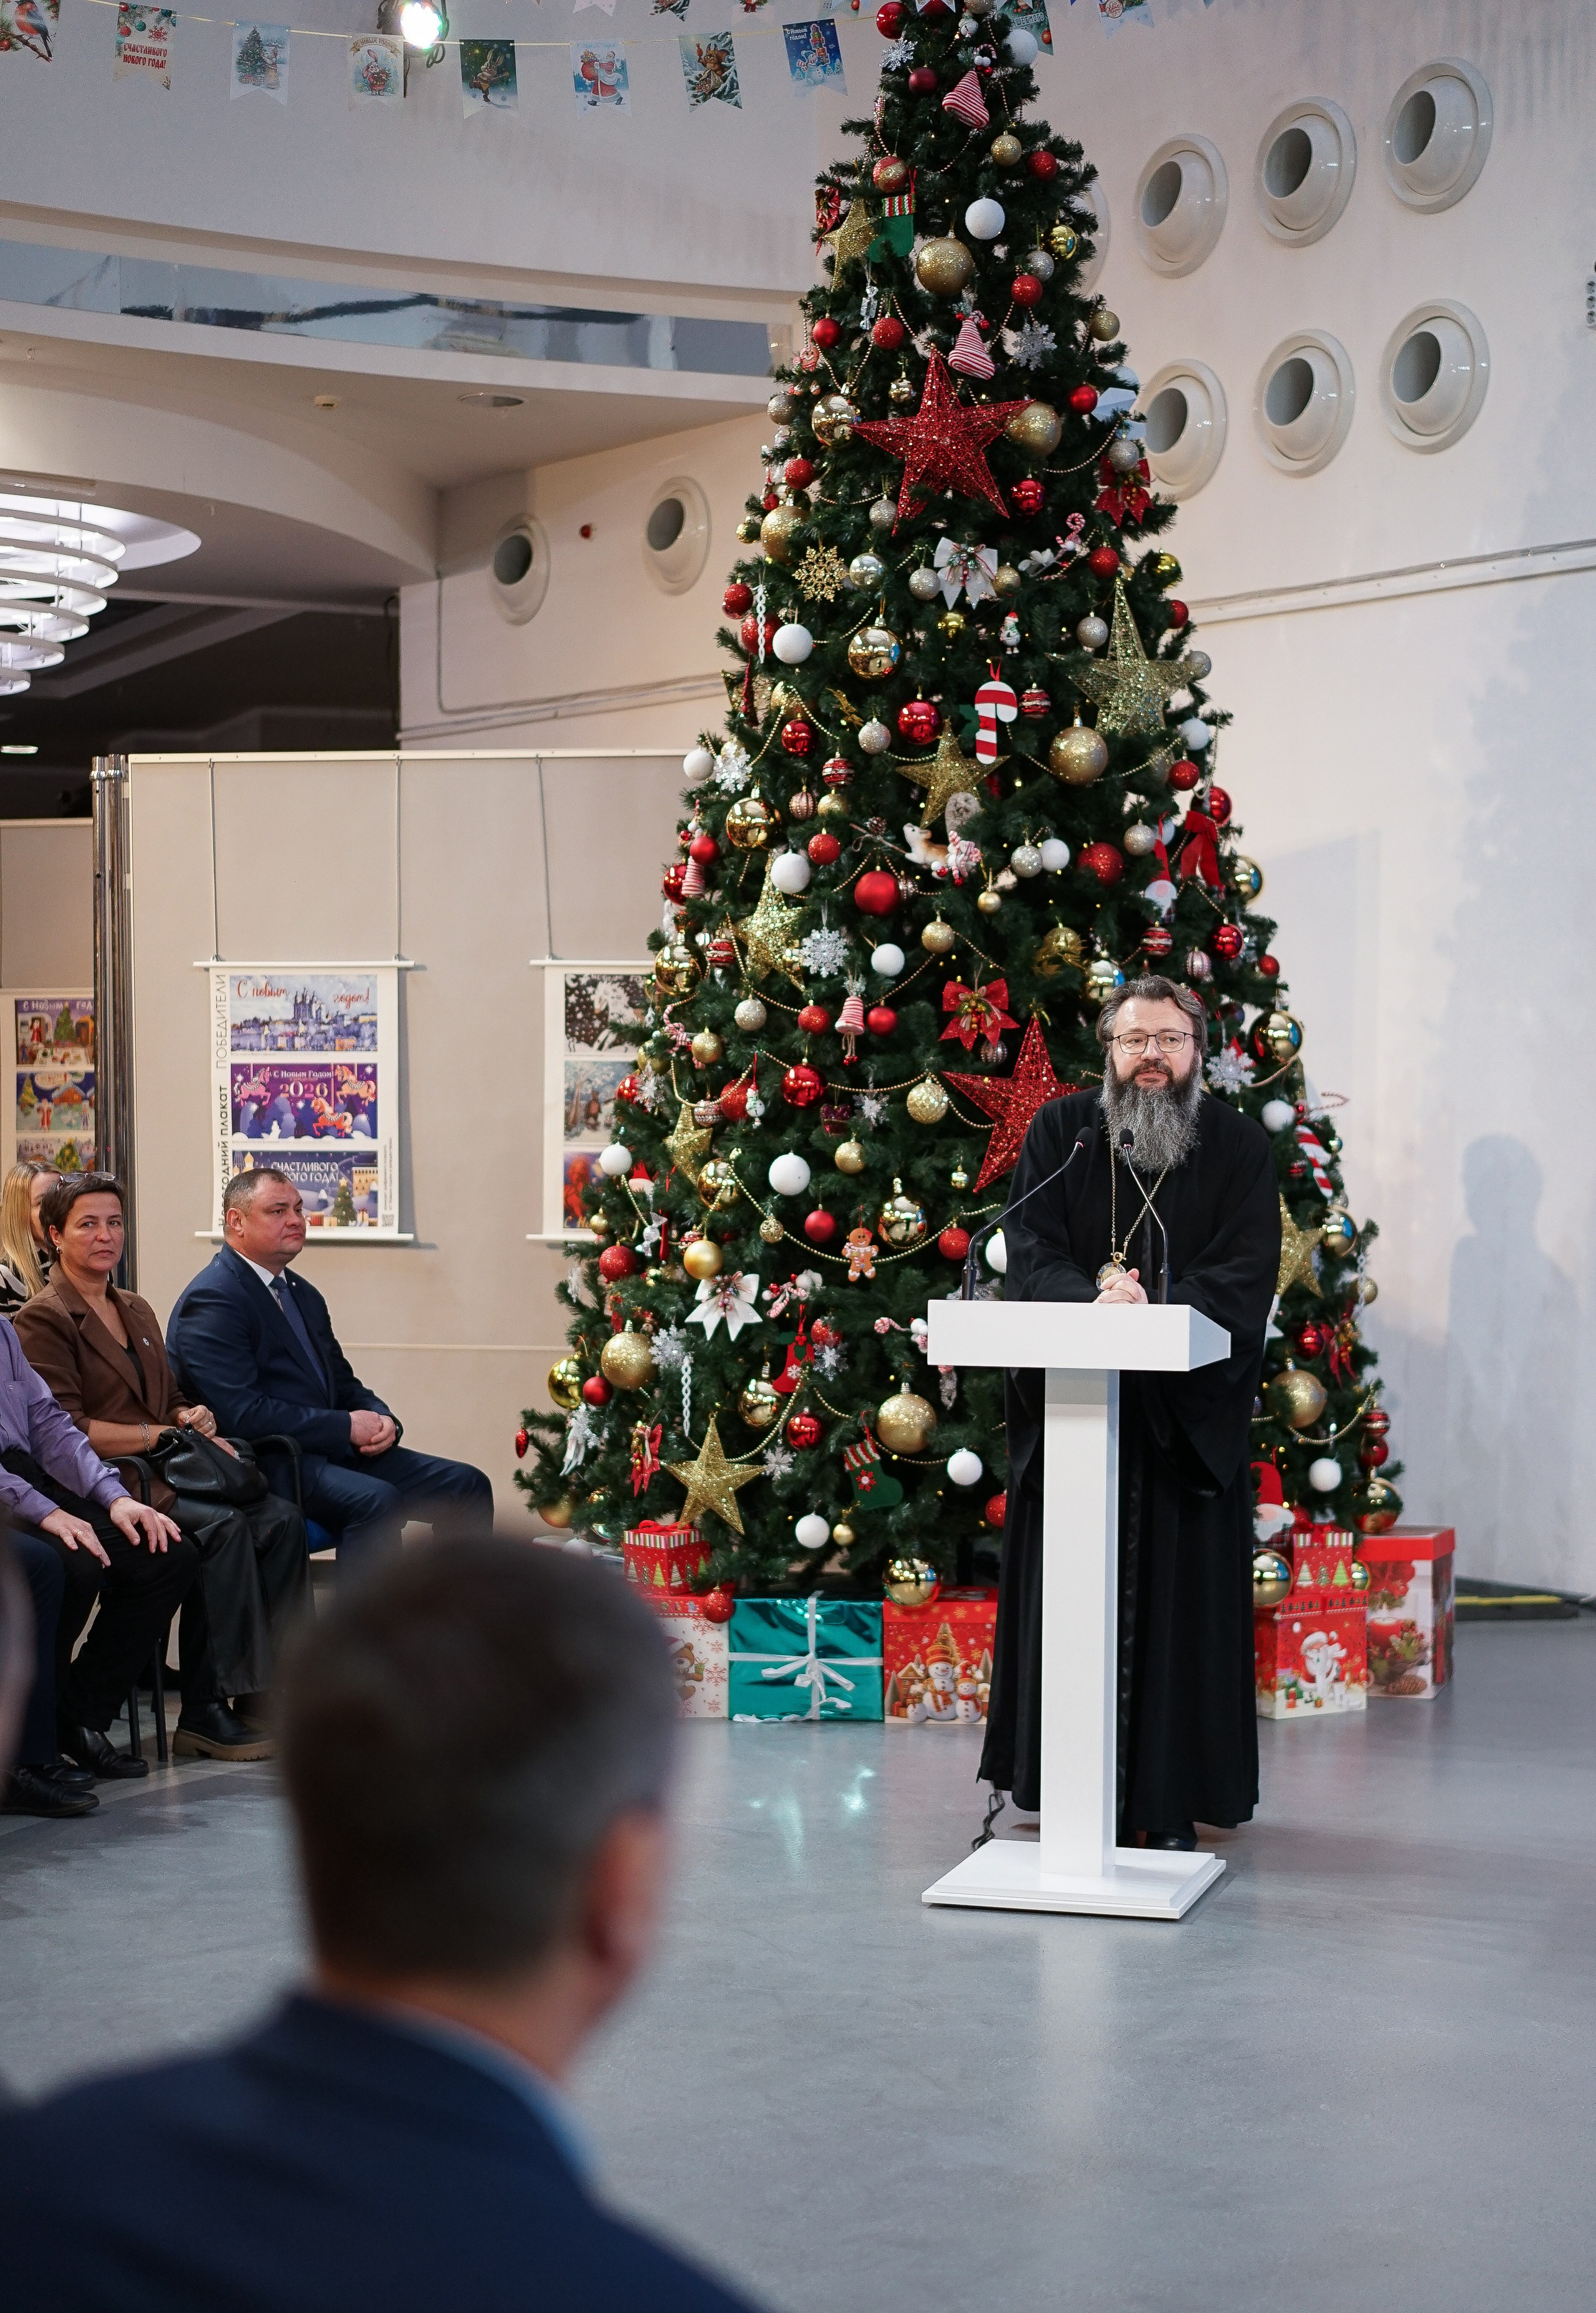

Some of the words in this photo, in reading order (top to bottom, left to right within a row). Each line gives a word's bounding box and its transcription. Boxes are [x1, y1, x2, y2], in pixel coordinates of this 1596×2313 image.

[123, 42, 168, 57] СЧАСТЛИВОГО
[123, 54, 147, 66] НОВОГО
[148, 58, 166, 70] ГОДА!
[238, 978, 248, 999] С
[216, 974, 228, 1069] ПОБЕДИТЕЛИ
[274, 1070, 280, 1078] С
[281, 1070, 307, 1079] Новым
[279, 1081, 329, 1098] 2026
[271, 1161, 339, 1172] СЧАСТЛИВОГО
[310, 1171, 339, 1184] ГОДА!
